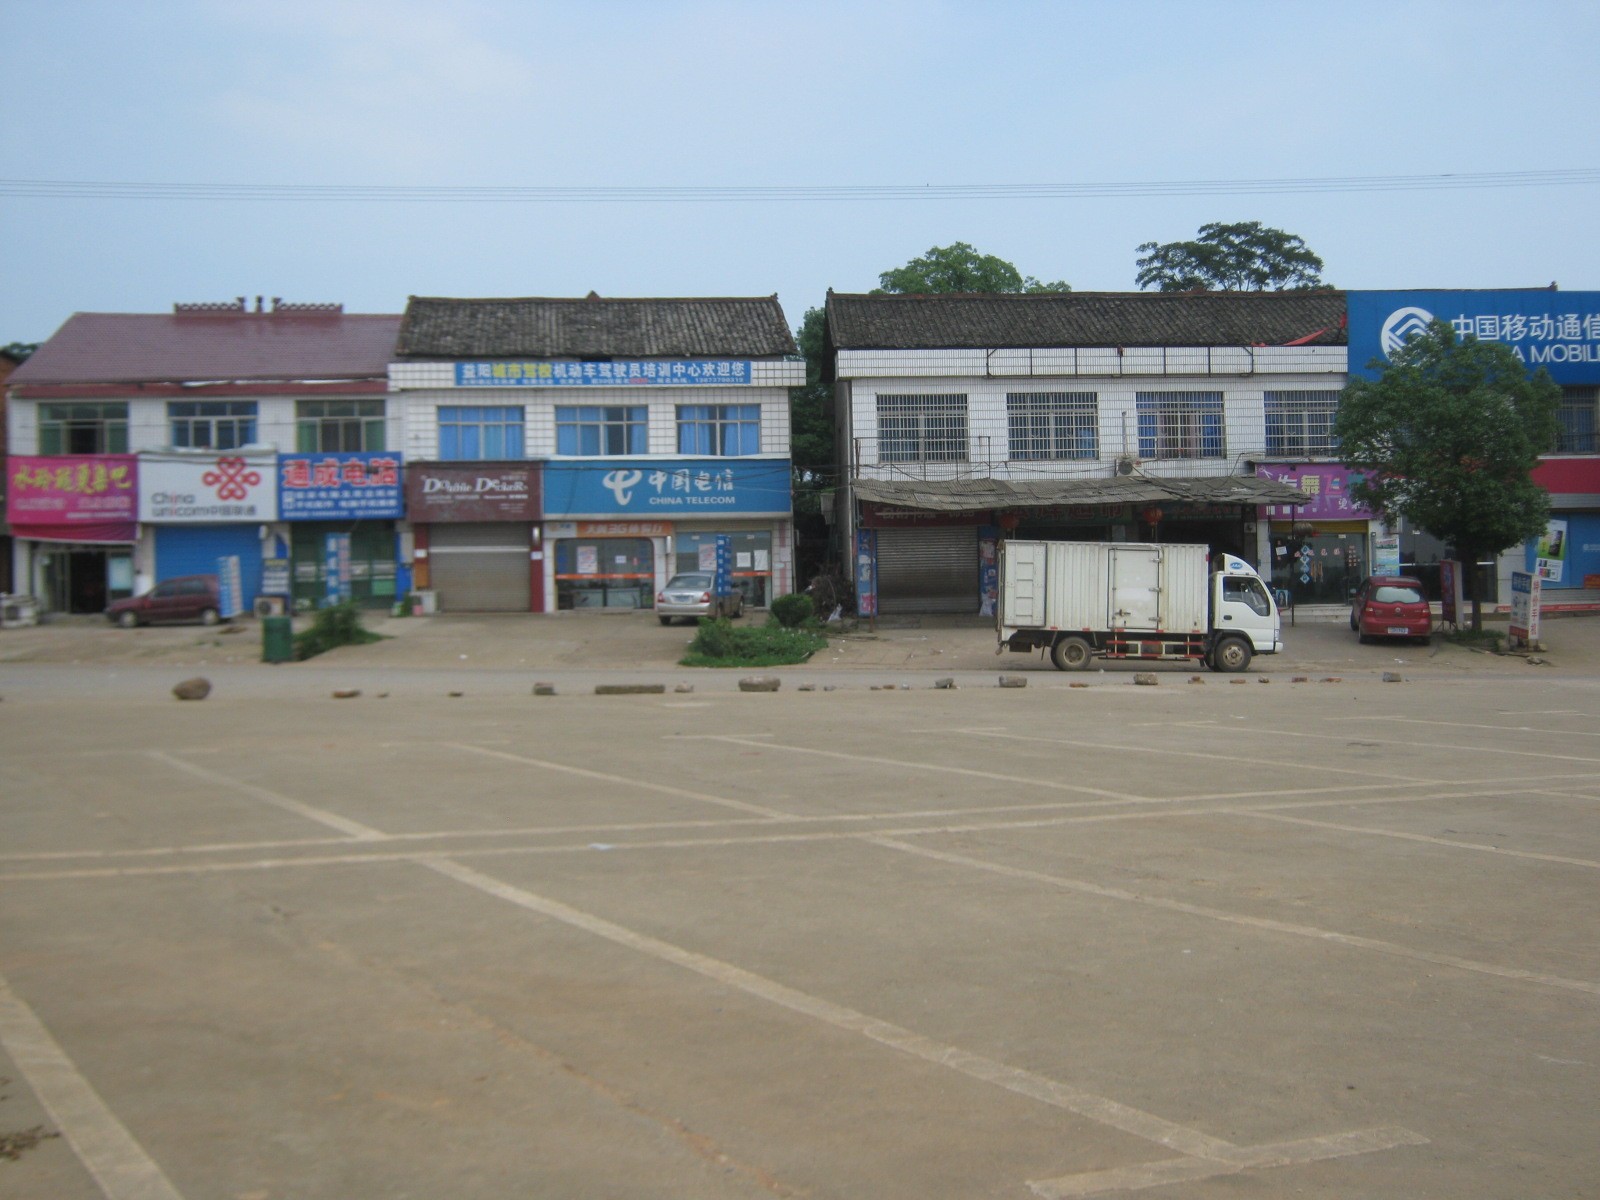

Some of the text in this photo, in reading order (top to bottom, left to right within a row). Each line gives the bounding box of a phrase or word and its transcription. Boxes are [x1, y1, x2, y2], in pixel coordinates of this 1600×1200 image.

[1452, 313, 1600, 341] 中国移动通信
[282, 457, 399, 488] 通成电脑
[648, 468, 734, 494] 中国电信
[686, 496, 735, 504] TELECOM
